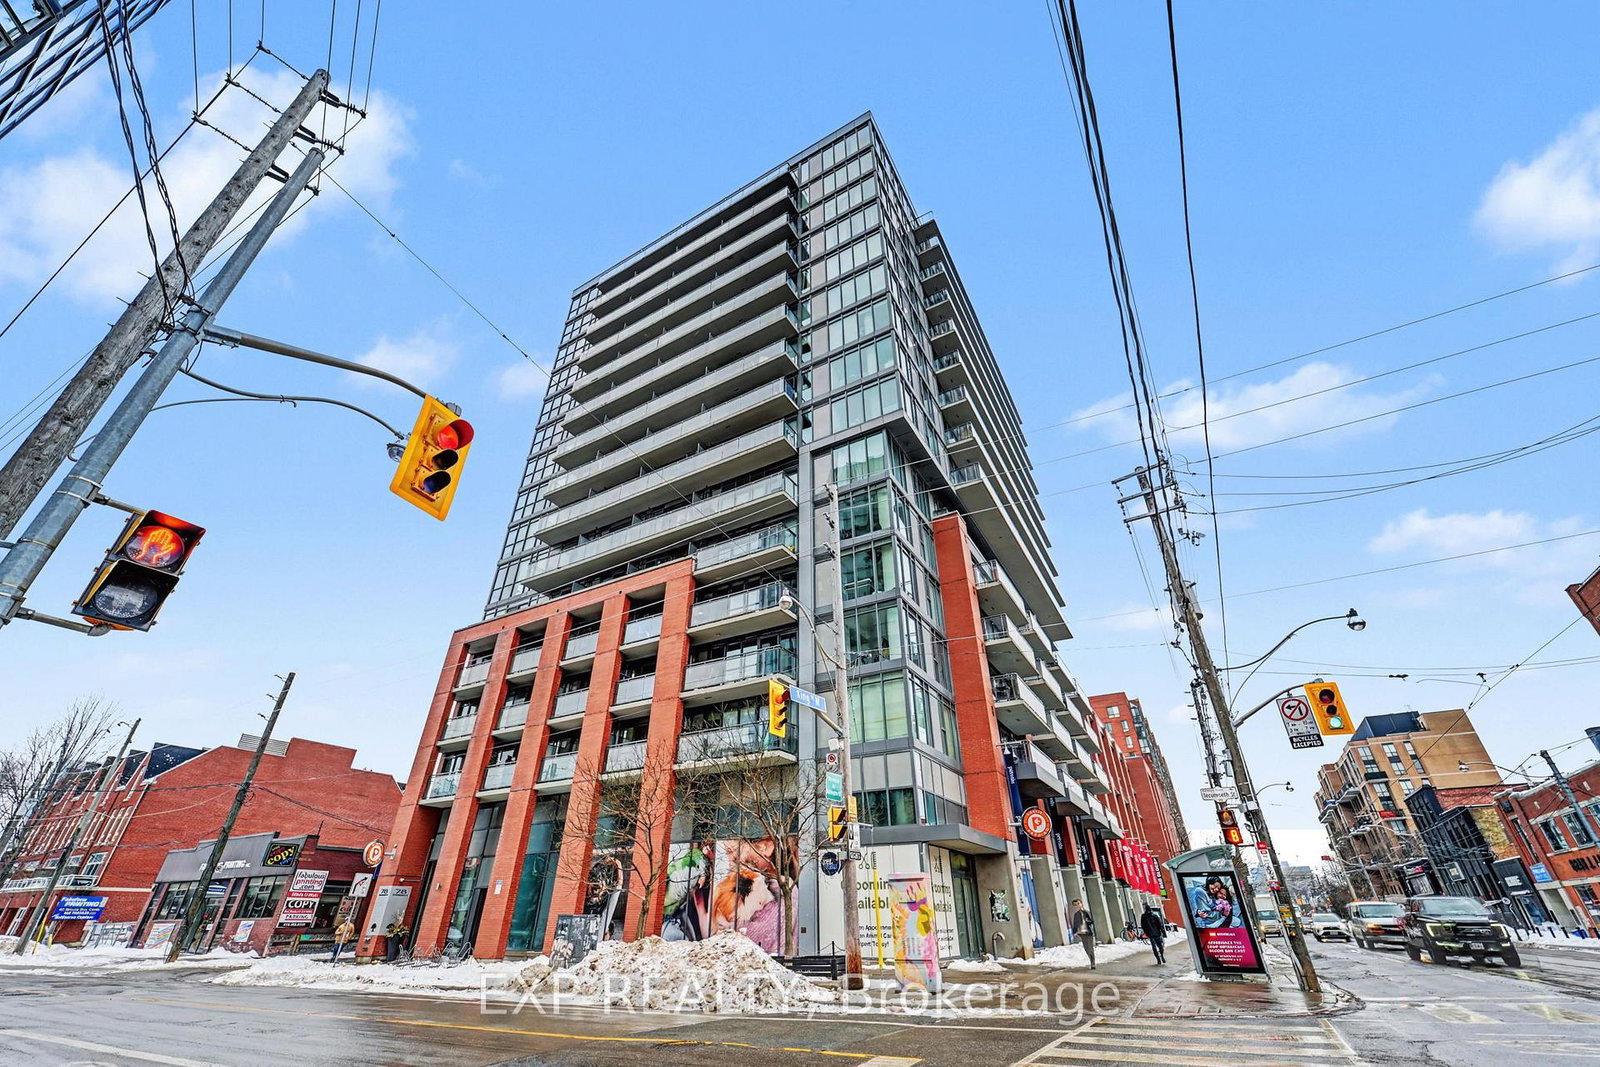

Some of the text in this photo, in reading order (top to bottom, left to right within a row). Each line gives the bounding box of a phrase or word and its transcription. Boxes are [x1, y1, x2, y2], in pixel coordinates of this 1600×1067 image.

[1292, 734, 1319, 743] BICYCLES
[267, 846, 295, 866] copy
[298, 871, 326, 879] fabulous
[295, 879, 323, 887] printing
[288, 899, 315, 909] COPY
